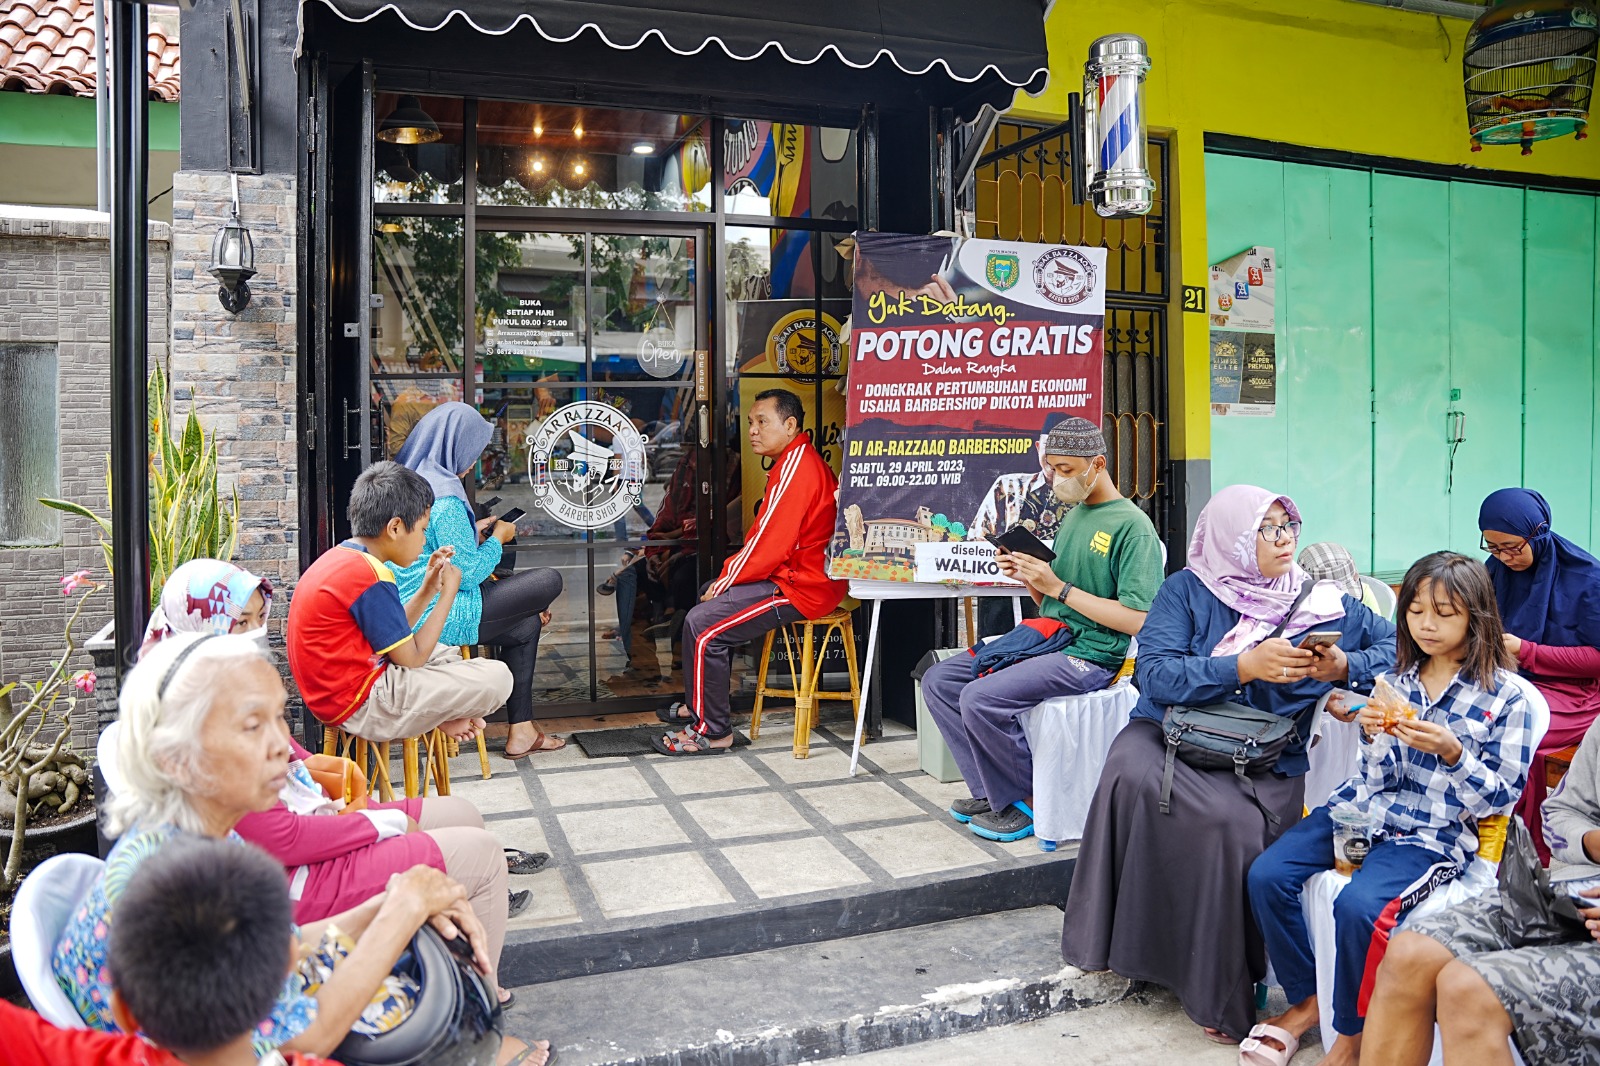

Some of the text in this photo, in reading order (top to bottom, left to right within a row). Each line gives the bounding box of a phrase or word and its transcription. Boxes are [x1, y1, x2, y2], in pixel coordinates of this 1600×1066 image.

[867, 291, 914, 324] Yuk
[1184, 288, 1203, 310] 21
[492, 318, 519, 326] PUKUL
[794, 320, 834, 337] RAZZAQ
[856, 324, 1094, 361] POTONG GRATIS
[642, 340, 682, 368] Open
[922, 360, 1016, 377] Dalam Rangka
[864, 382, 932, 398] DONGKRAK
[935, 380, 1029, 396] PERTUMBUHAN
[1030, 378, 1087, 393] EKONOMI
[859, 399, 902, 414] USAHA
[904, 396, 986, 412] BARBERSHOP
[988, 395, 1035, 410] DIKOTA
[849, 438, 1032, 458] DI AR-RAZZAAQ BARBERSHOP
[610, 460, 624, 470] 2023
[850, 460, 966, 476] SABTU, 29 APRIL 2023,
[850, 473, 962, 488] PKL. 09.00-22.00 WIB
[558, 502, 618, 522] BARBER SHOP
